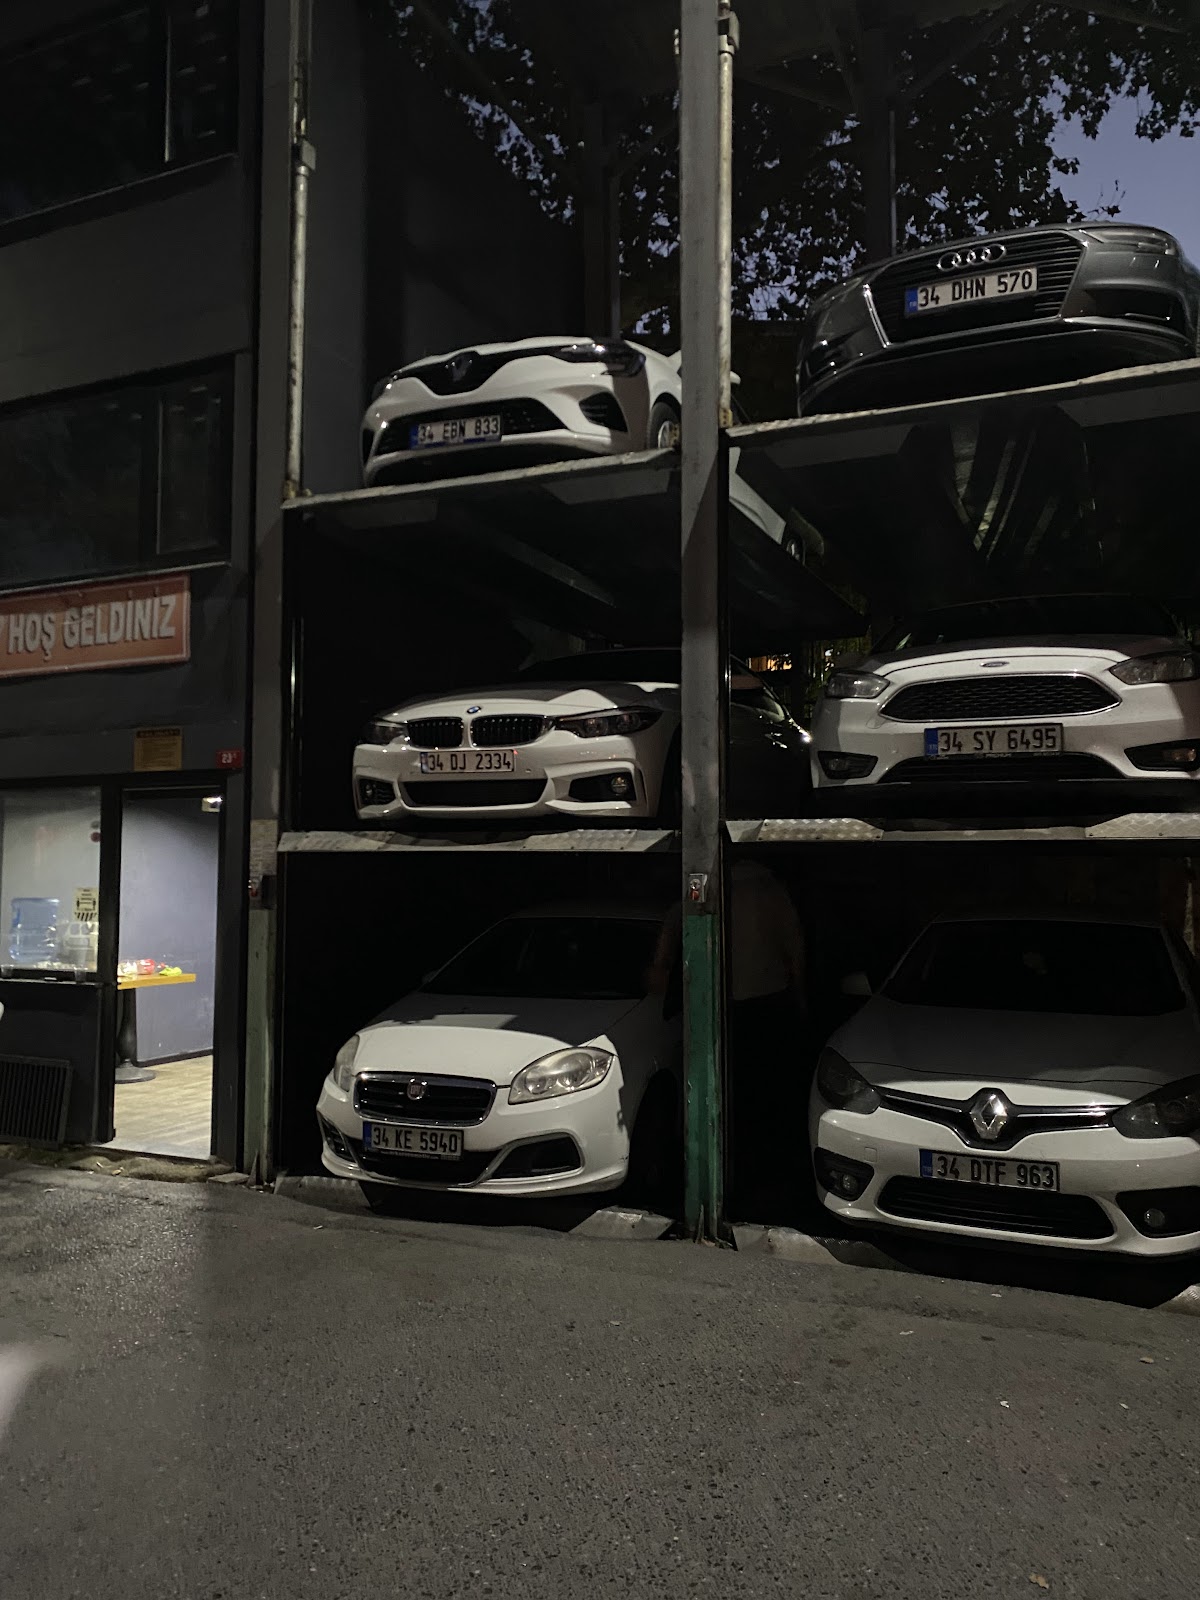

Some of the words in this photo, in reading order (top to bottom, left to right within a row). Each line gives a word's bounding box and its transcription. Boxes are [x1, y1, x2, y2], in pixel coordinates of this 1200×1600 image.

[919, 286, 940, 307] 34
[951, 277, 986, 301] DHN
[997, 270, 1033, 293] 570
[443, 421, 466, 440] EBN
[475, 417, 499, 436] 833
[8, 612, 56, 661] HOŞ
[940, 732, 963, 752] 34
[973, 730, 996, 751] SY
[1007, 727, 1056, 750] 6495
[428, 754, 443, 771] 34
[450, 753, 466, 771] DJ
[475, 752, 511, 770] 2334
[373, 1126, 389, 1147] 34
[395, 1129, 412, 1149] KE
[420, 1131, 458, 1153] 5940
[937, 1156, 960, 1179] 34
[970, 1159, 1006, 1183] DTF
[1016, 1164, 1054, 1188] 963
